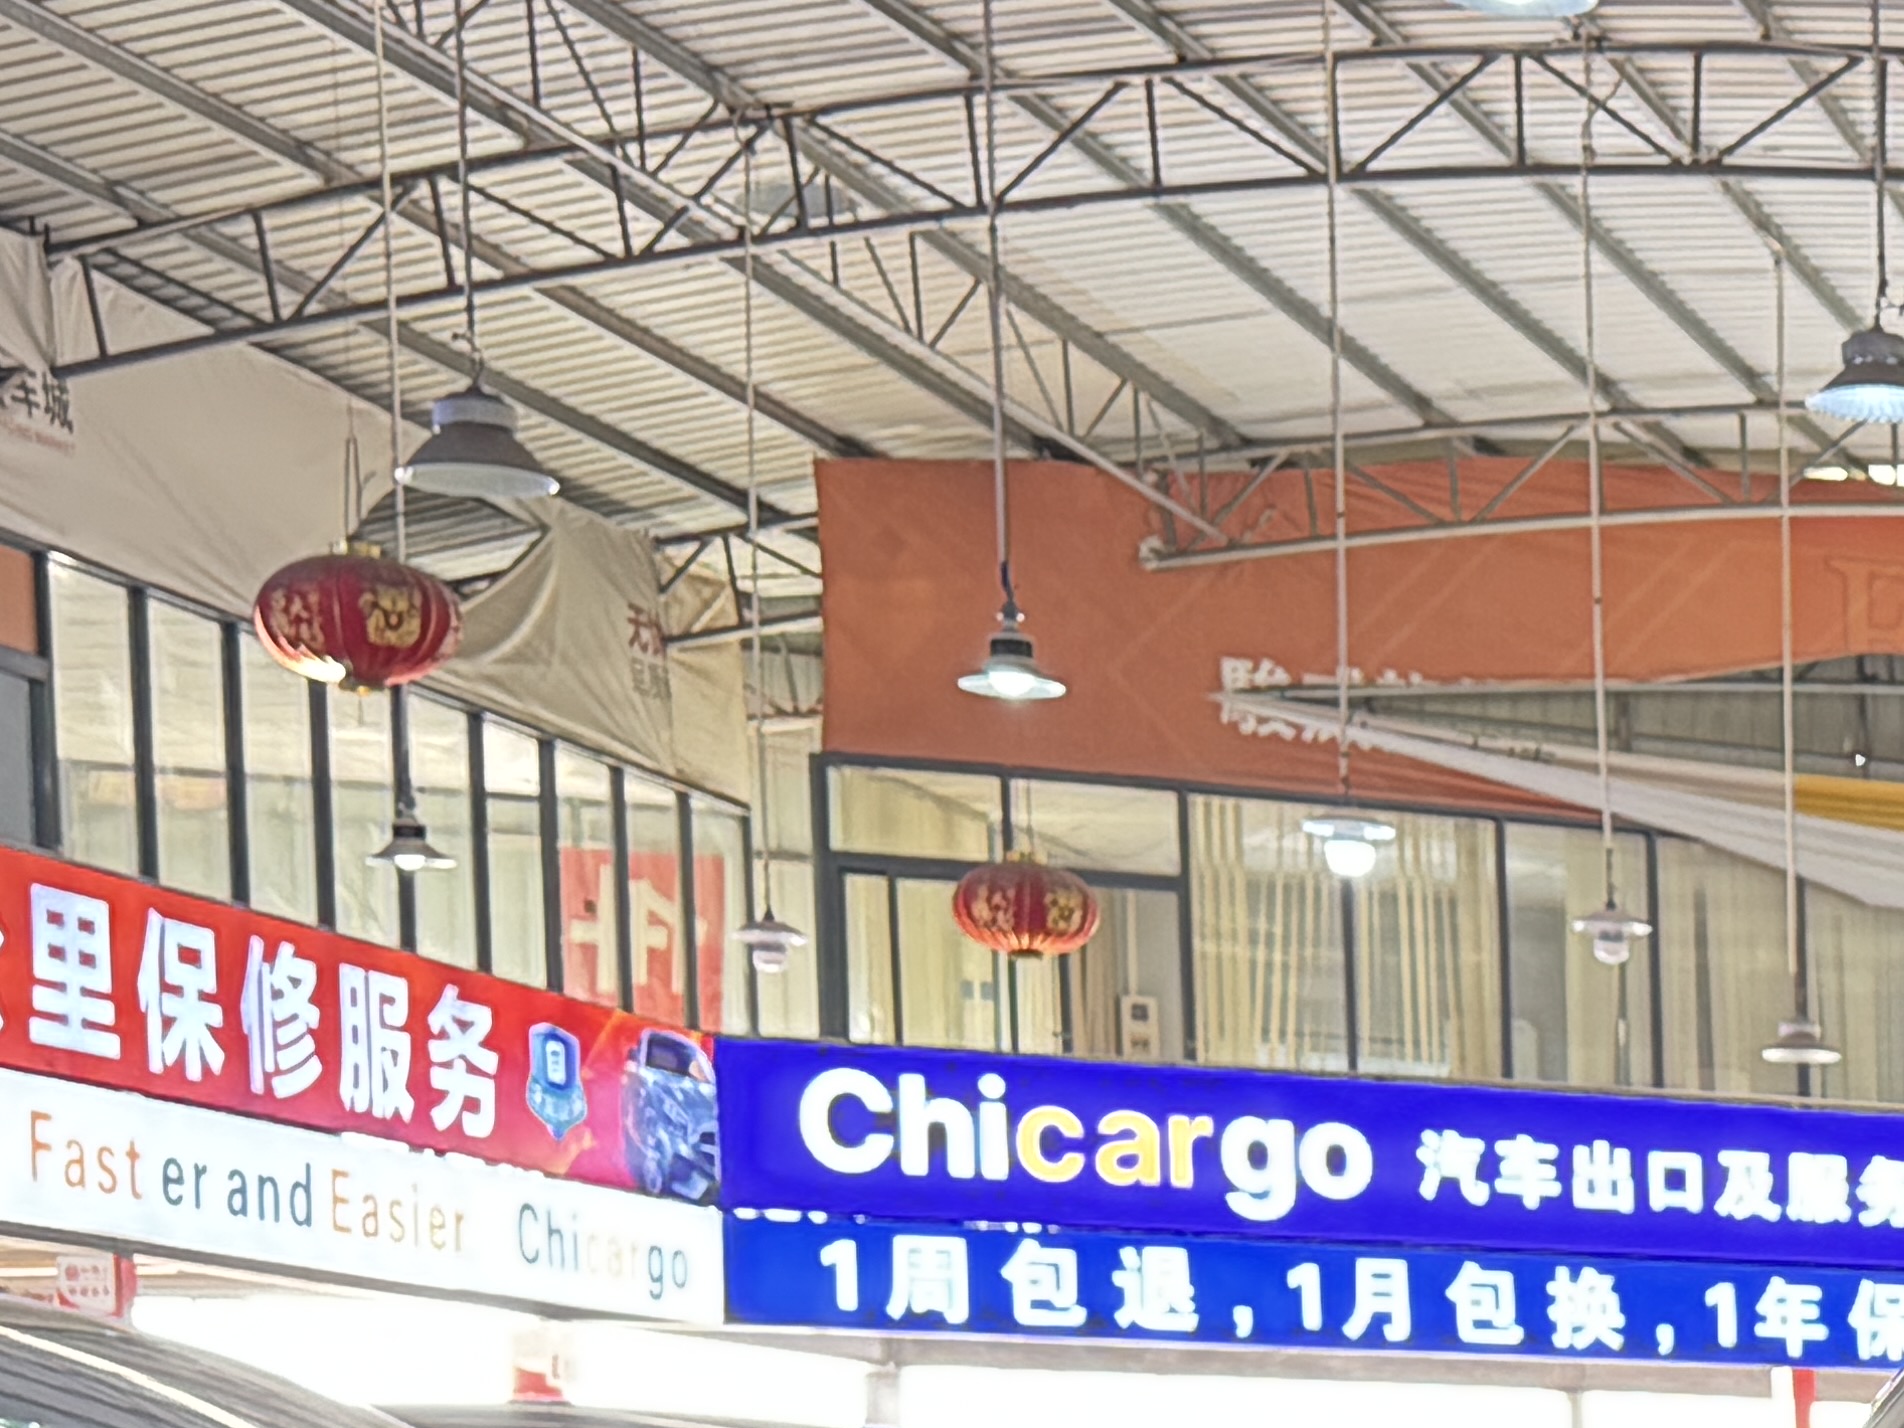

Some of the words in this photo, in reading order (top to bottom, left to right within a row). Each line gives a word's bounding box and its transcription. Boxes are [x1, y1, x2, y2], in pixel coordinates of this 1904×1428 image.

[0, 882, 500, 1139] 里保修服务
[226, 1161, 313, 1228] and
[330, 1167, 465, 1252] Easier
[799, 1067, 1374, 1222] Chicargo
